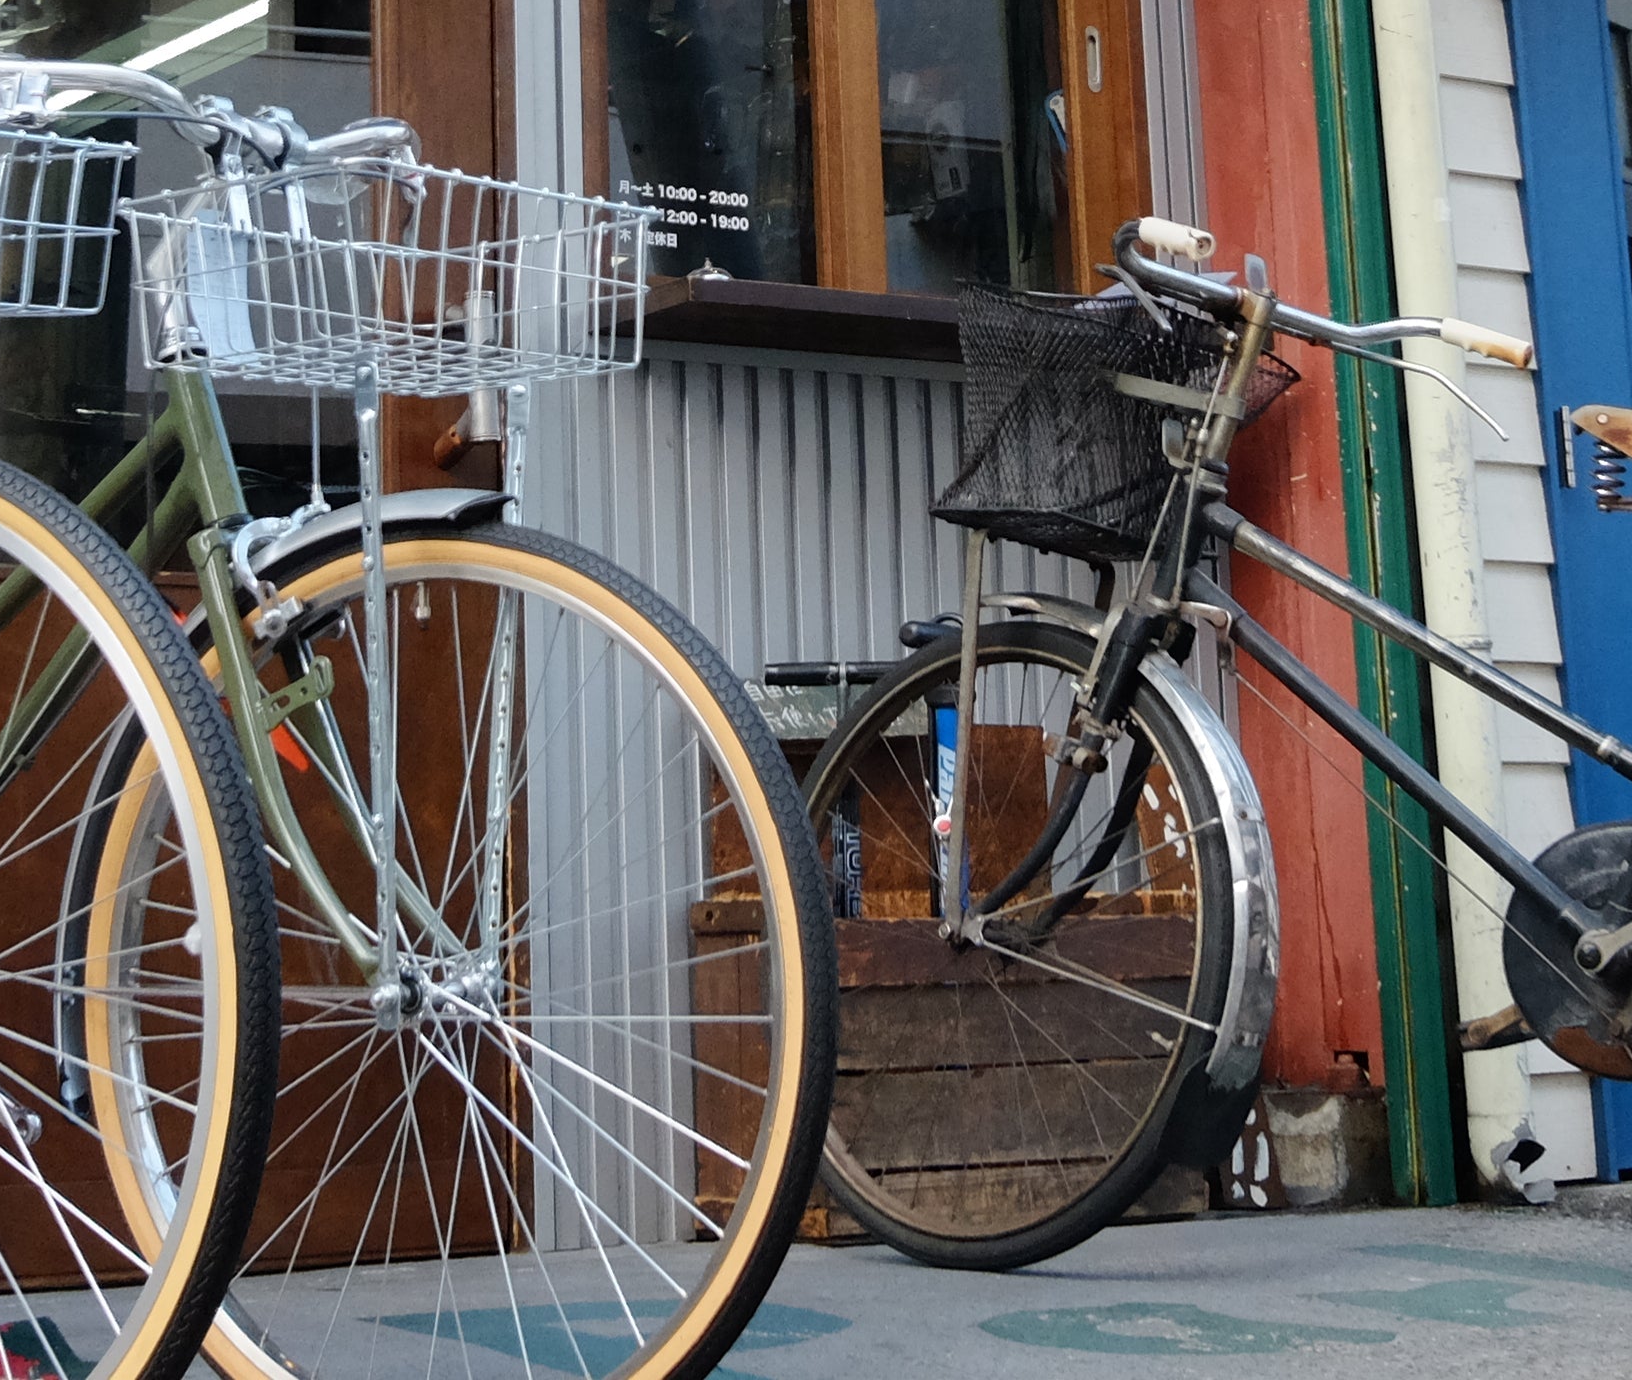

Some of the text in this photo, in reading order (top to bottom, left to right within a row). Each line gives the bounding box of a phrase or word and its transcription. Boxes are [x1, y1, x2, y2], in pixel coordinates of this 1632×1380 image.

[658, 183, 698, 202] 10:00
[709, 190, 749, 208] 20:00
[660, 207, 698, 226] 12:00
[710, 213, 750, 232] 19:00
